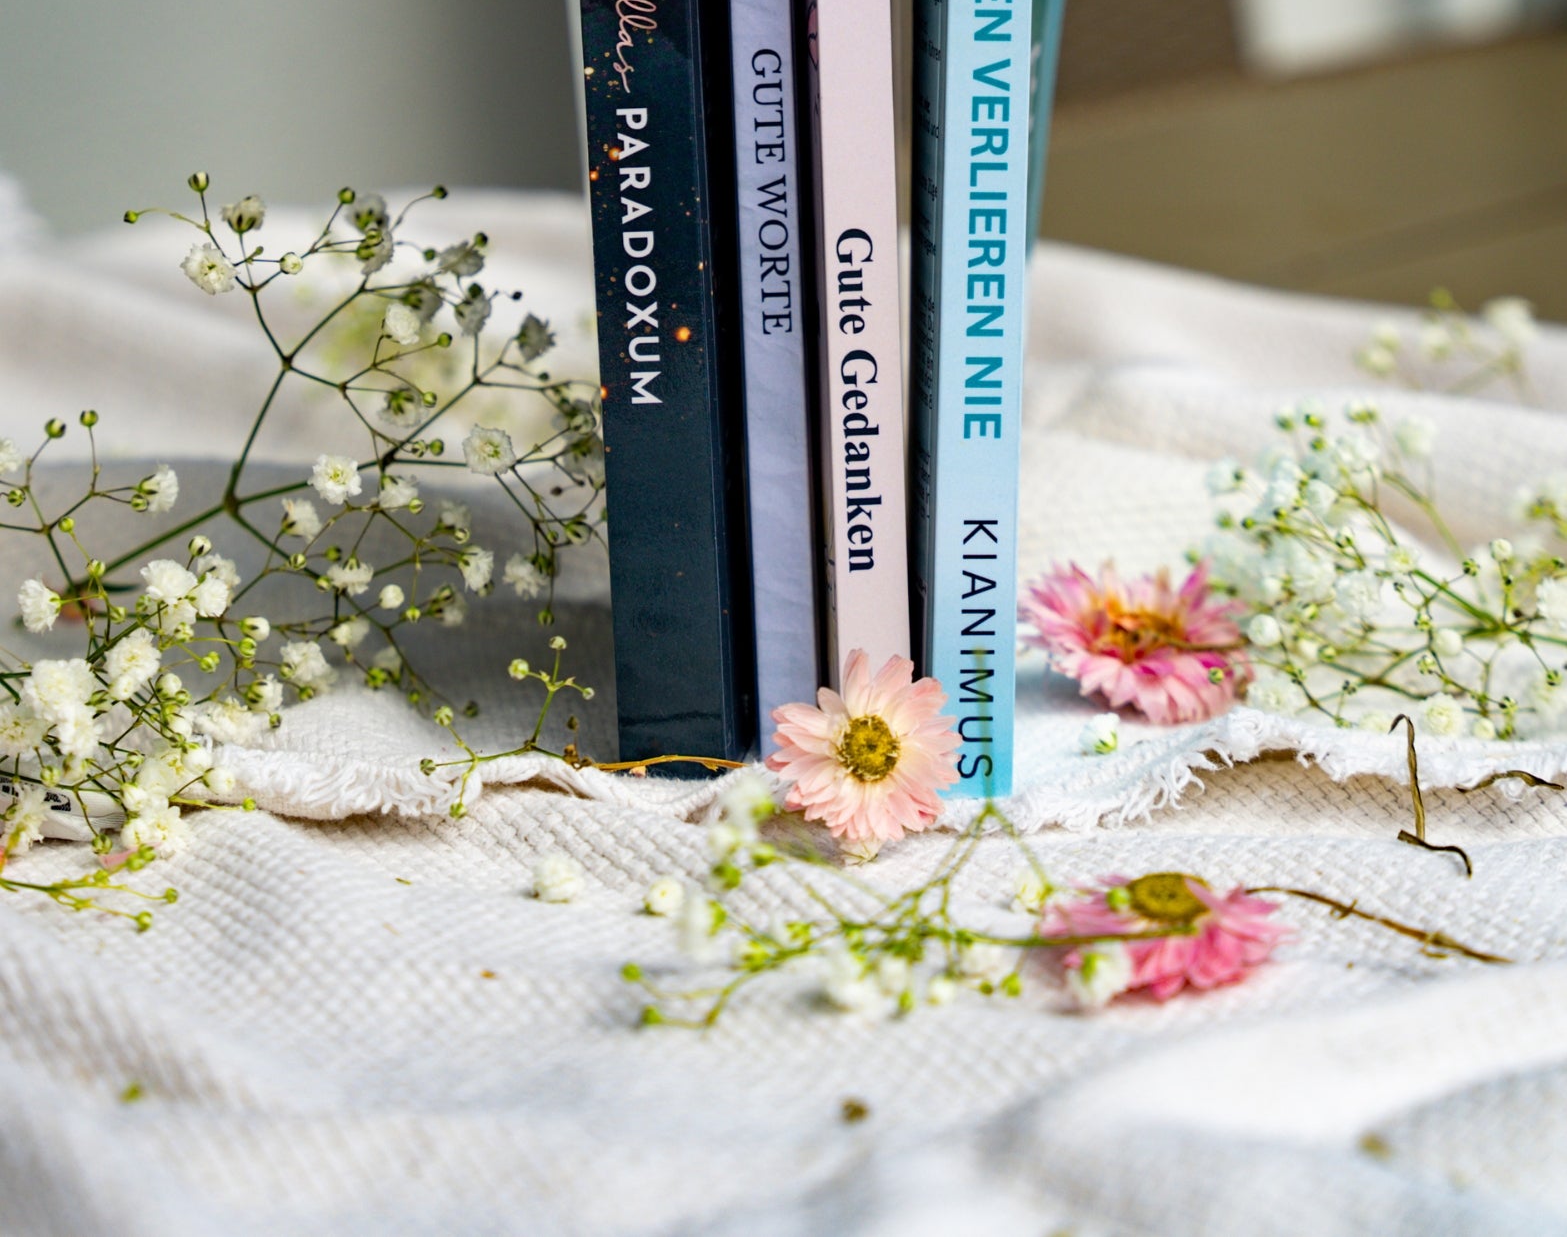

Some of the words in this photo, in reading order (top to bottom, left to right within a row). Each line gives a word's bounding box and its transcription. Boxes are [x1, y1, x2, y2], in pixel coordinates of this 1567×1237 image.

[751, 48, 786, 165] GUTE
[965, 58, 1011, 338] VERLIEREN
[615, 107, 663, 405] PARADOXUM
[756, 173, 793, 336] WORTE
[835, 227, 874, 335] Gute
[840, 349, 882, 574] Gedanken
[963, 356, 1003, 440] NIE
[957, 519, 1000, 780] KIANIMUS
